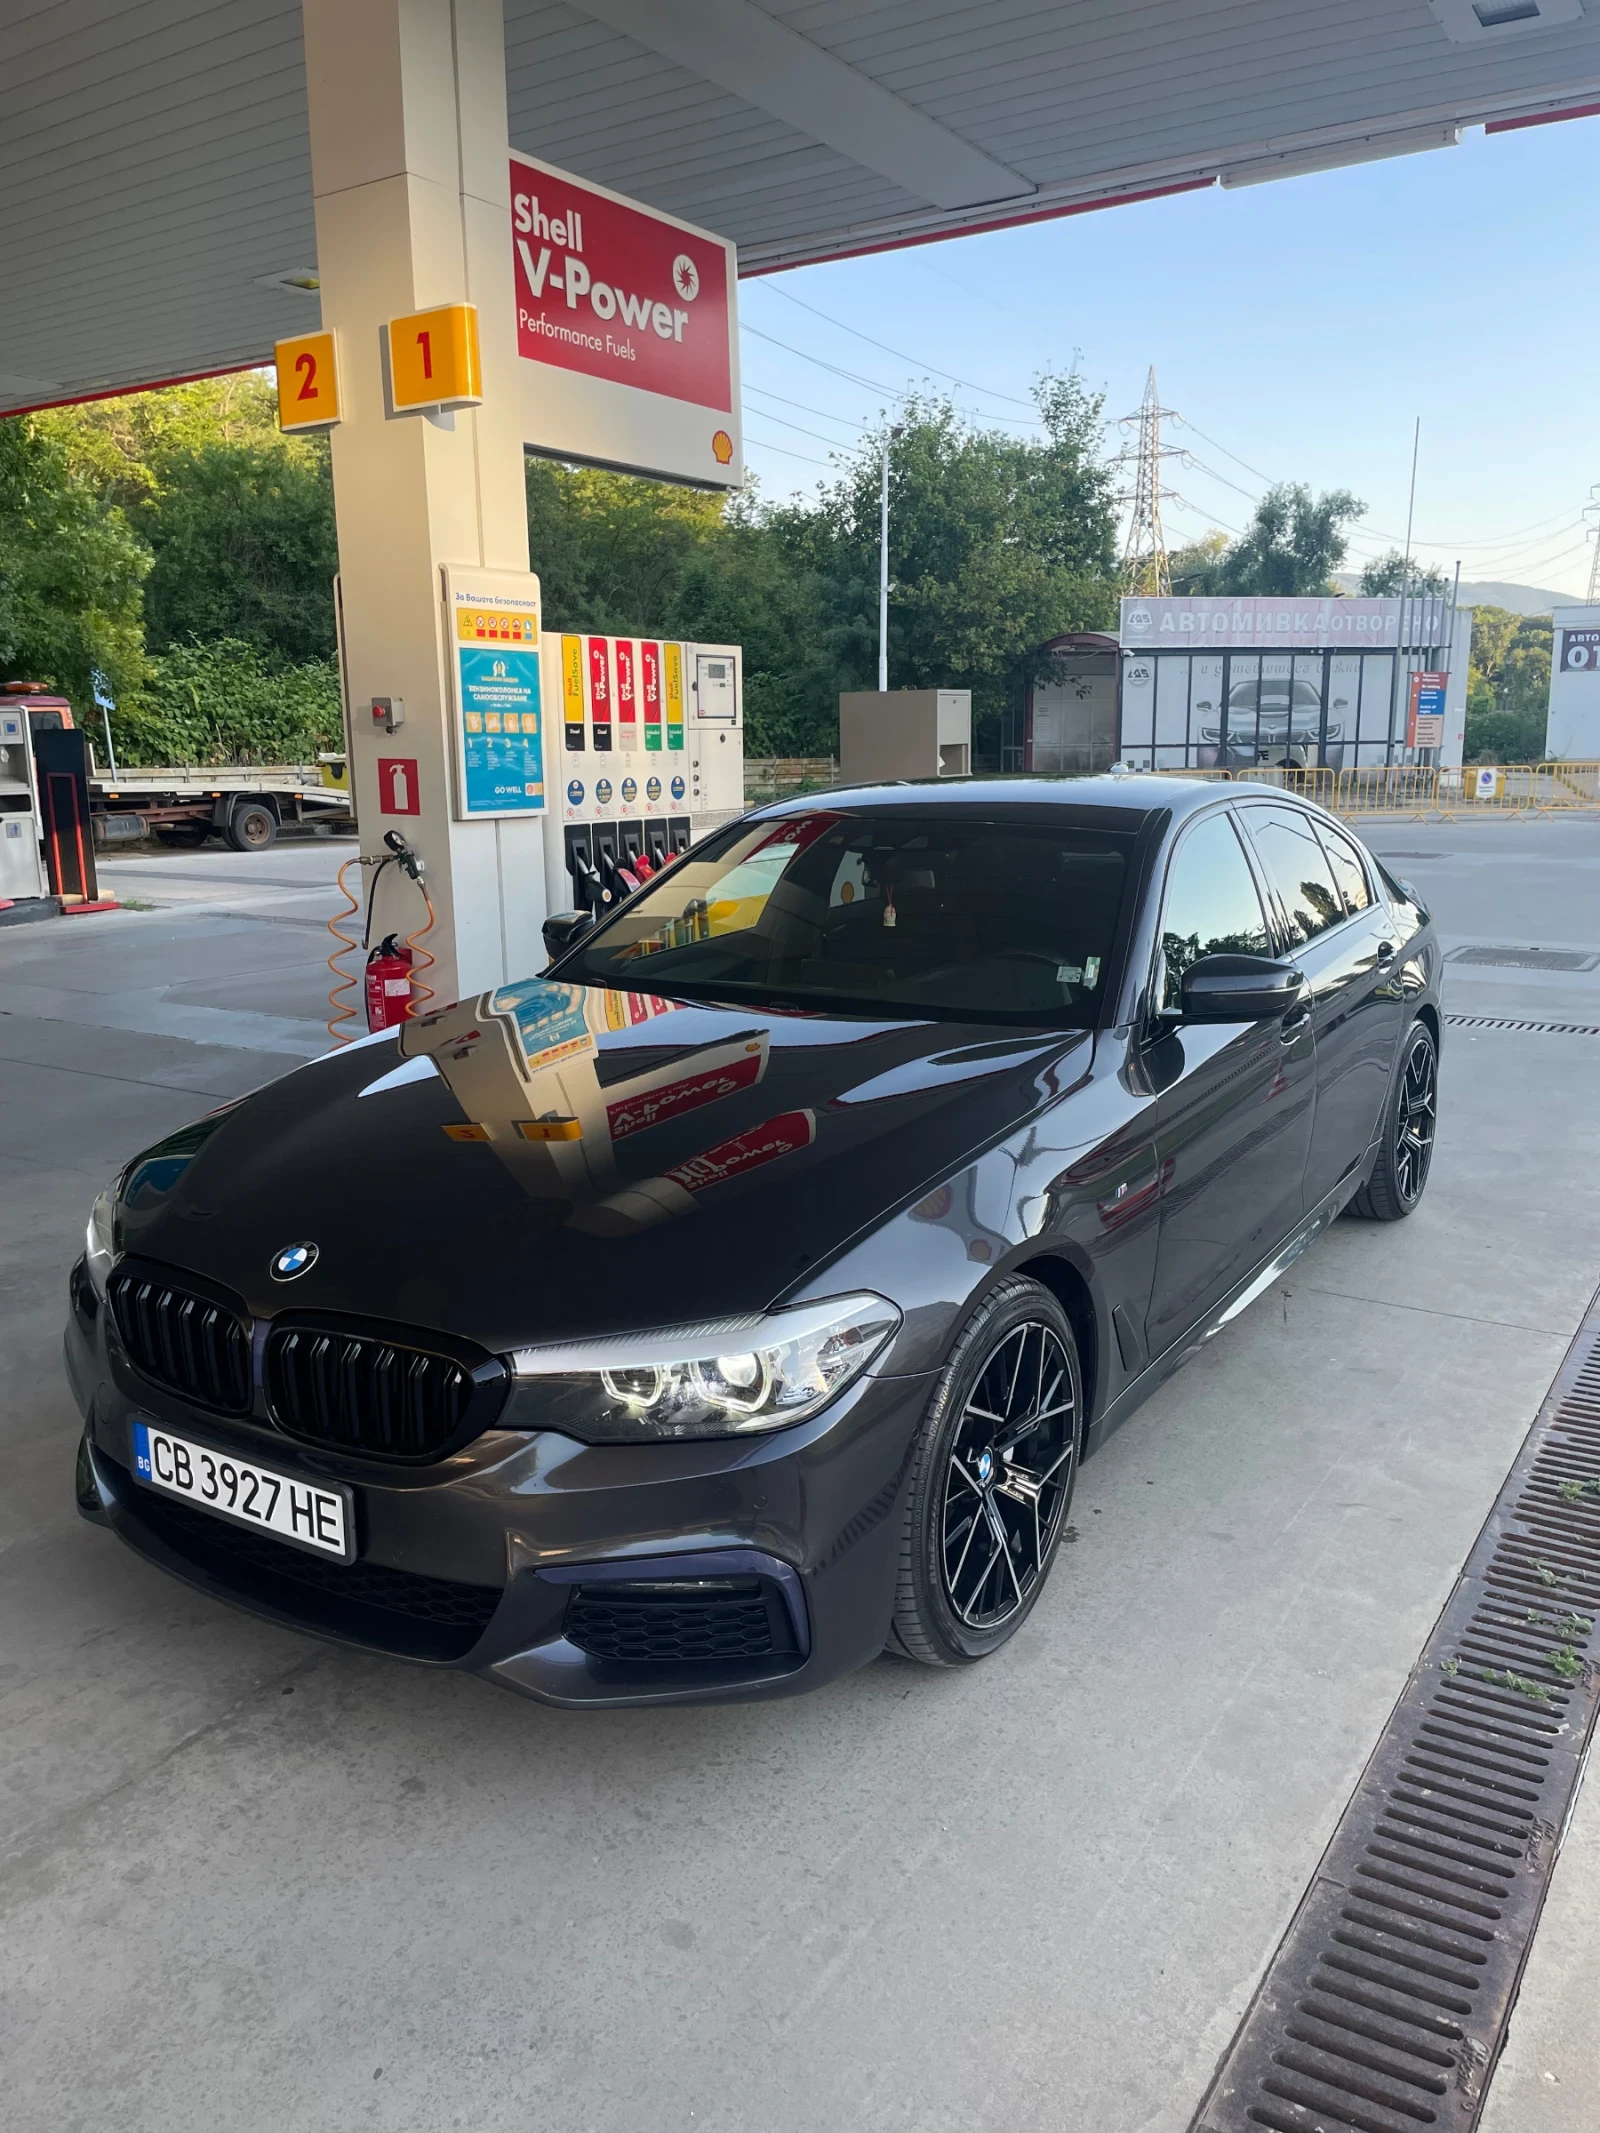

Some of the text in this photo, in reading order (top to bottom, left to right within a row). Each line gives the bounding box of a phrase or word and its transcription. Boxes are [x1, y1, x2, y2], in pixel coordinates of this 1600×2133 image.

[514, 194, 583, 252] Shell
[516, 240, 689, 343] V-Power
[416, 331, 433, 379] 1
[519, 308, 636, 362] Performance Fuels
[294, 353, 319, 402] 2
[455, 592, 465, 601] За
[466, 593, 493, 604] Вашата
[1159, 611, 1439, 633] АВТОМИВКА ОТВОРЕНО
[494, 786, 522, 794] GO WELL
[137, 1455, 151, 1472] BG
[153, 1435, 341, 1547] CB 3927 HE
